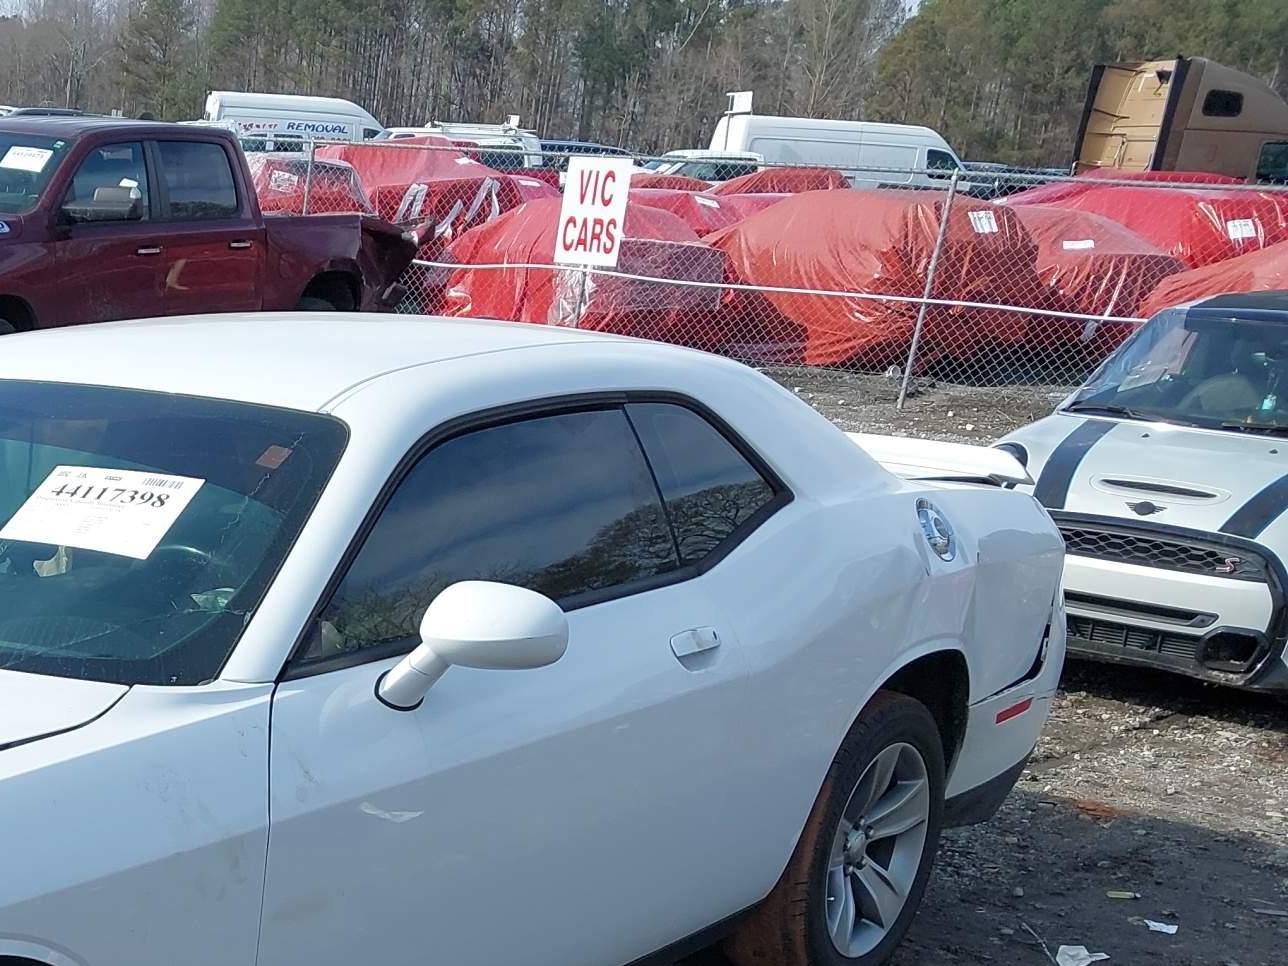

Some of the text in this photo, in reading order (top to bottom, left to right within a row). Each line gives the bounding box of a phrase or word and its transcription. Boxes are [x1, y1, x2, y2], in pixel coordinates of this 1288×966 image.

[287, 122, 348, 134] REMOVAL
[580, 169, 616, 207] VIC
[563, 215, 617, 254] CARS
[51, 483, 171, 508] 44117398
